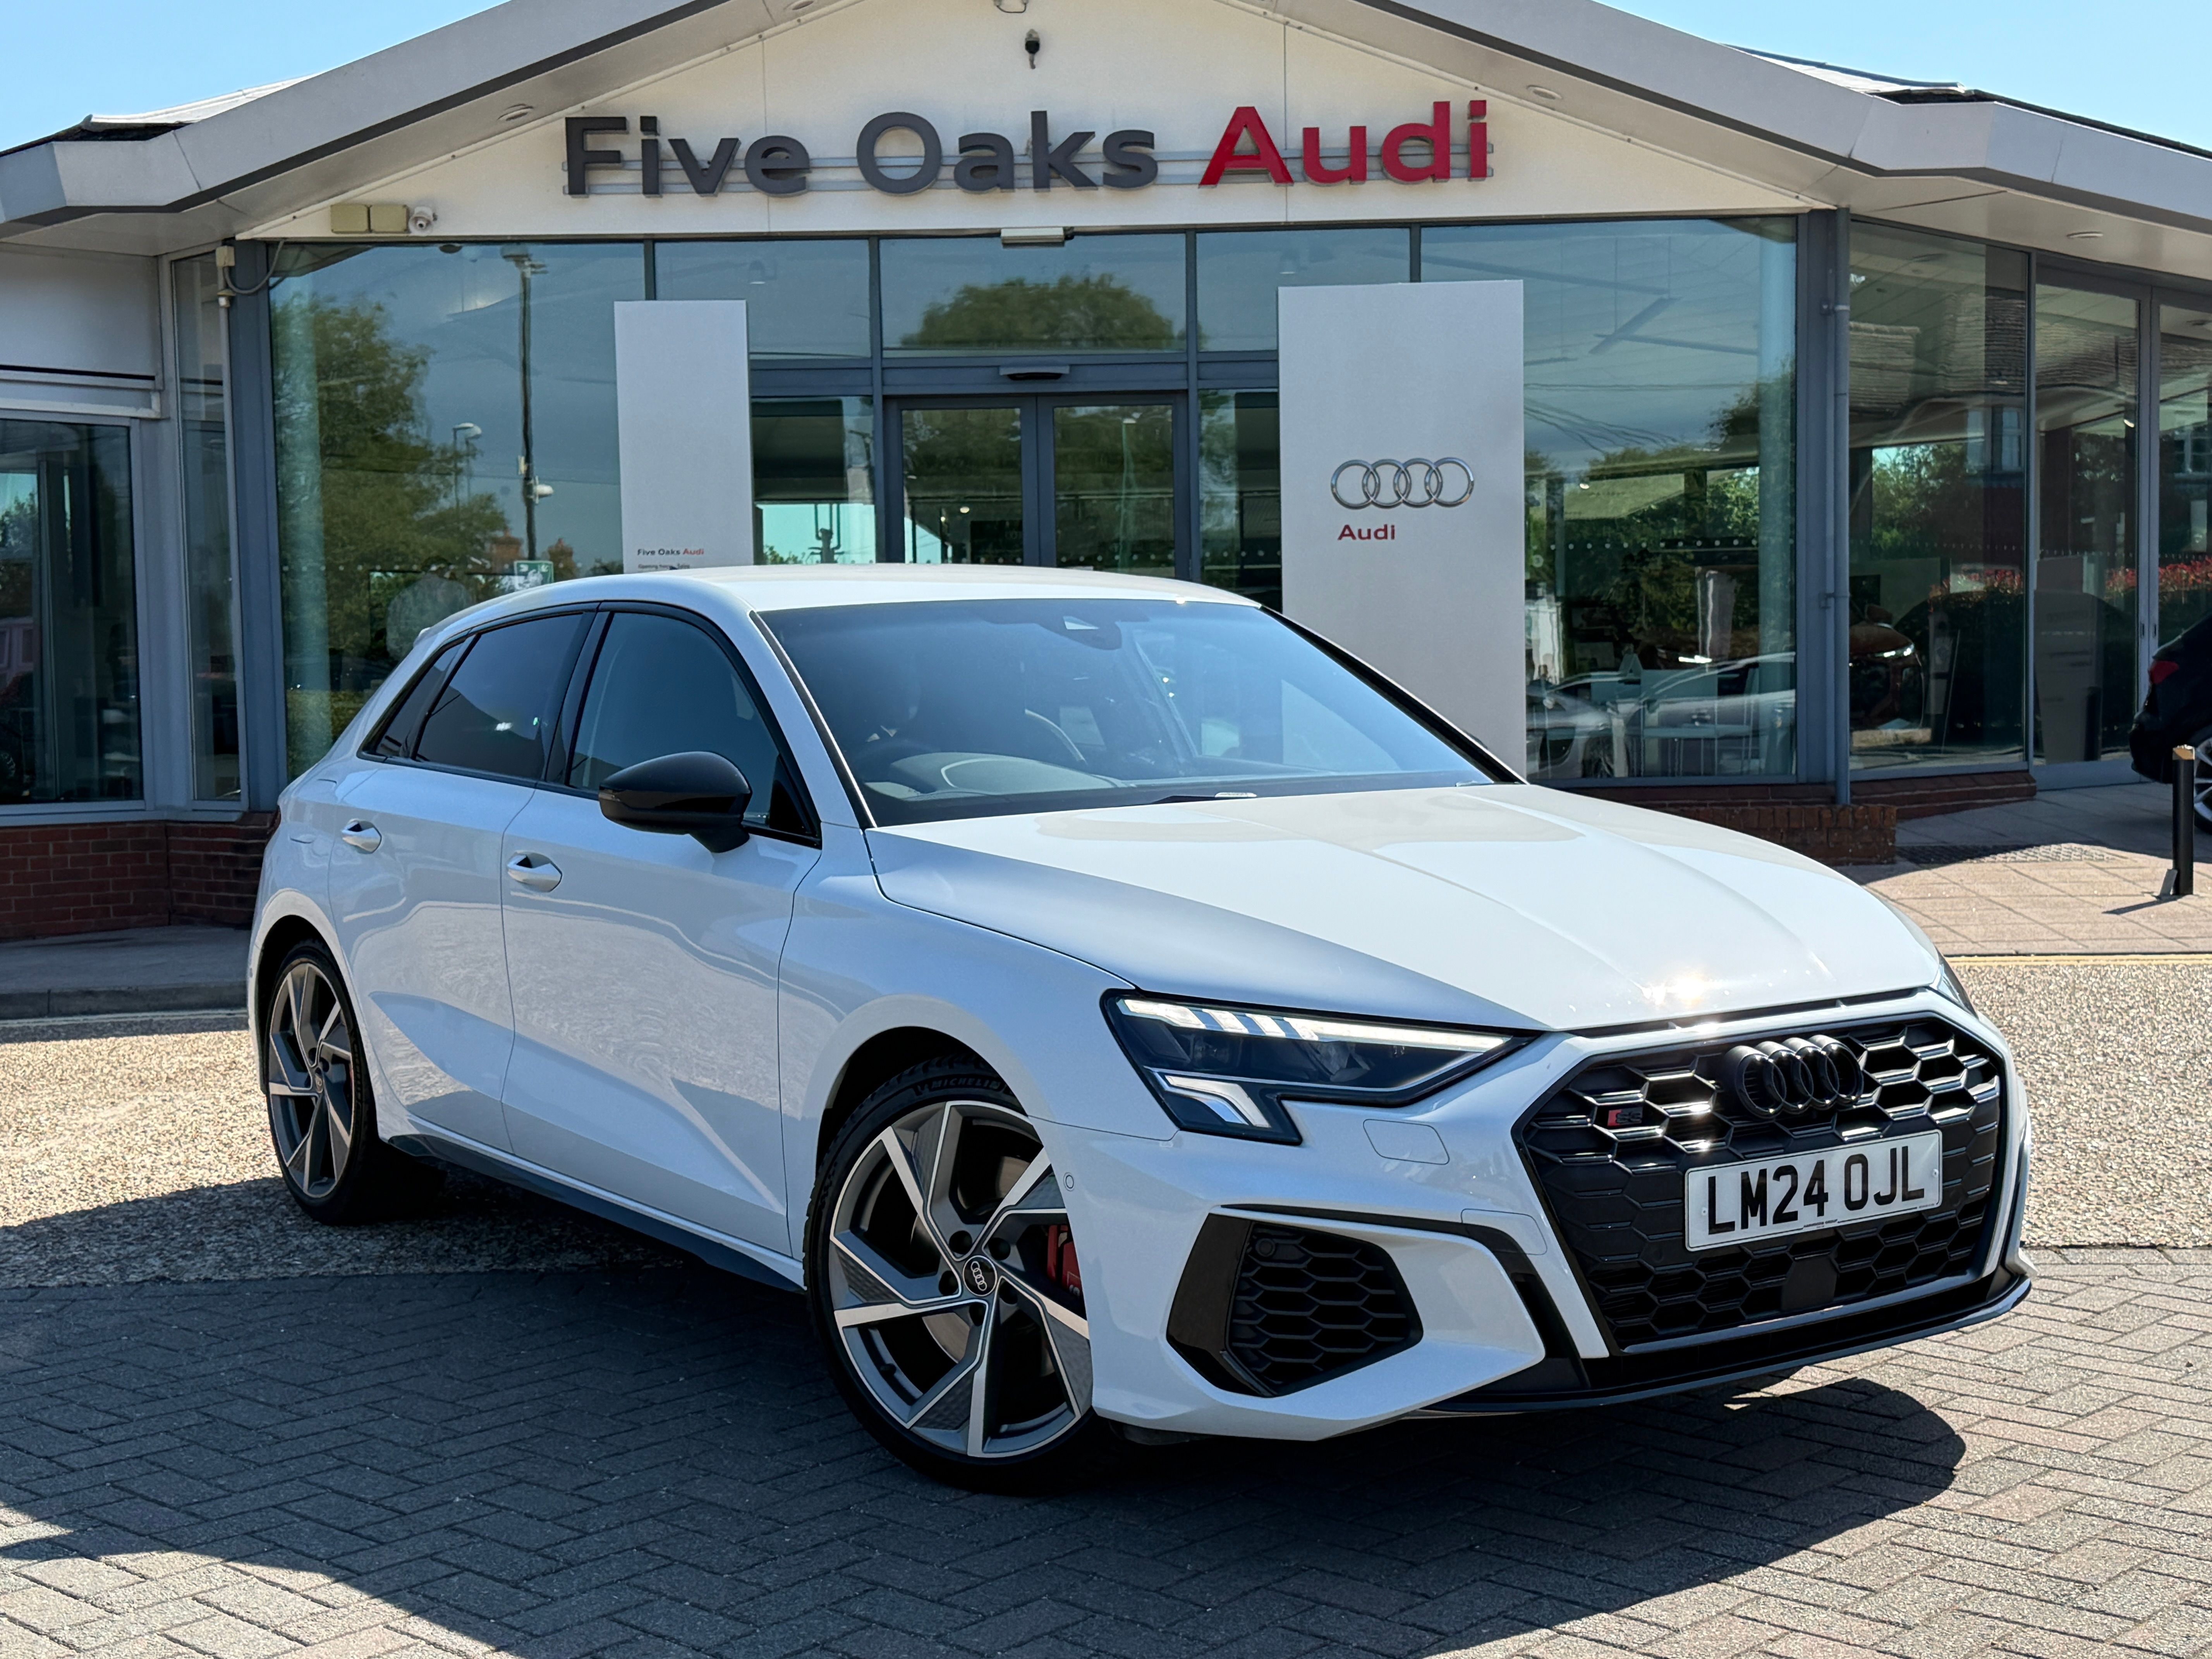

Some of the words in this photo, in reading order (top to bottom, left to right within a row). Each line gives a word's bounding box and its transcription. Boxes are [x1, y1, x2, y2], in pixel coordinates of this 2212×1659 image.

[565, 115, 811, 197] Five
[856, 110, 1158, 195] Oaks
[1198, 100, 1487, 188] Audi
[1338, 524, 1395, 541] Audi
[1708, 1159, 1829, 1235] LM24
[1844, 1146, 1925, 1211] OJL
